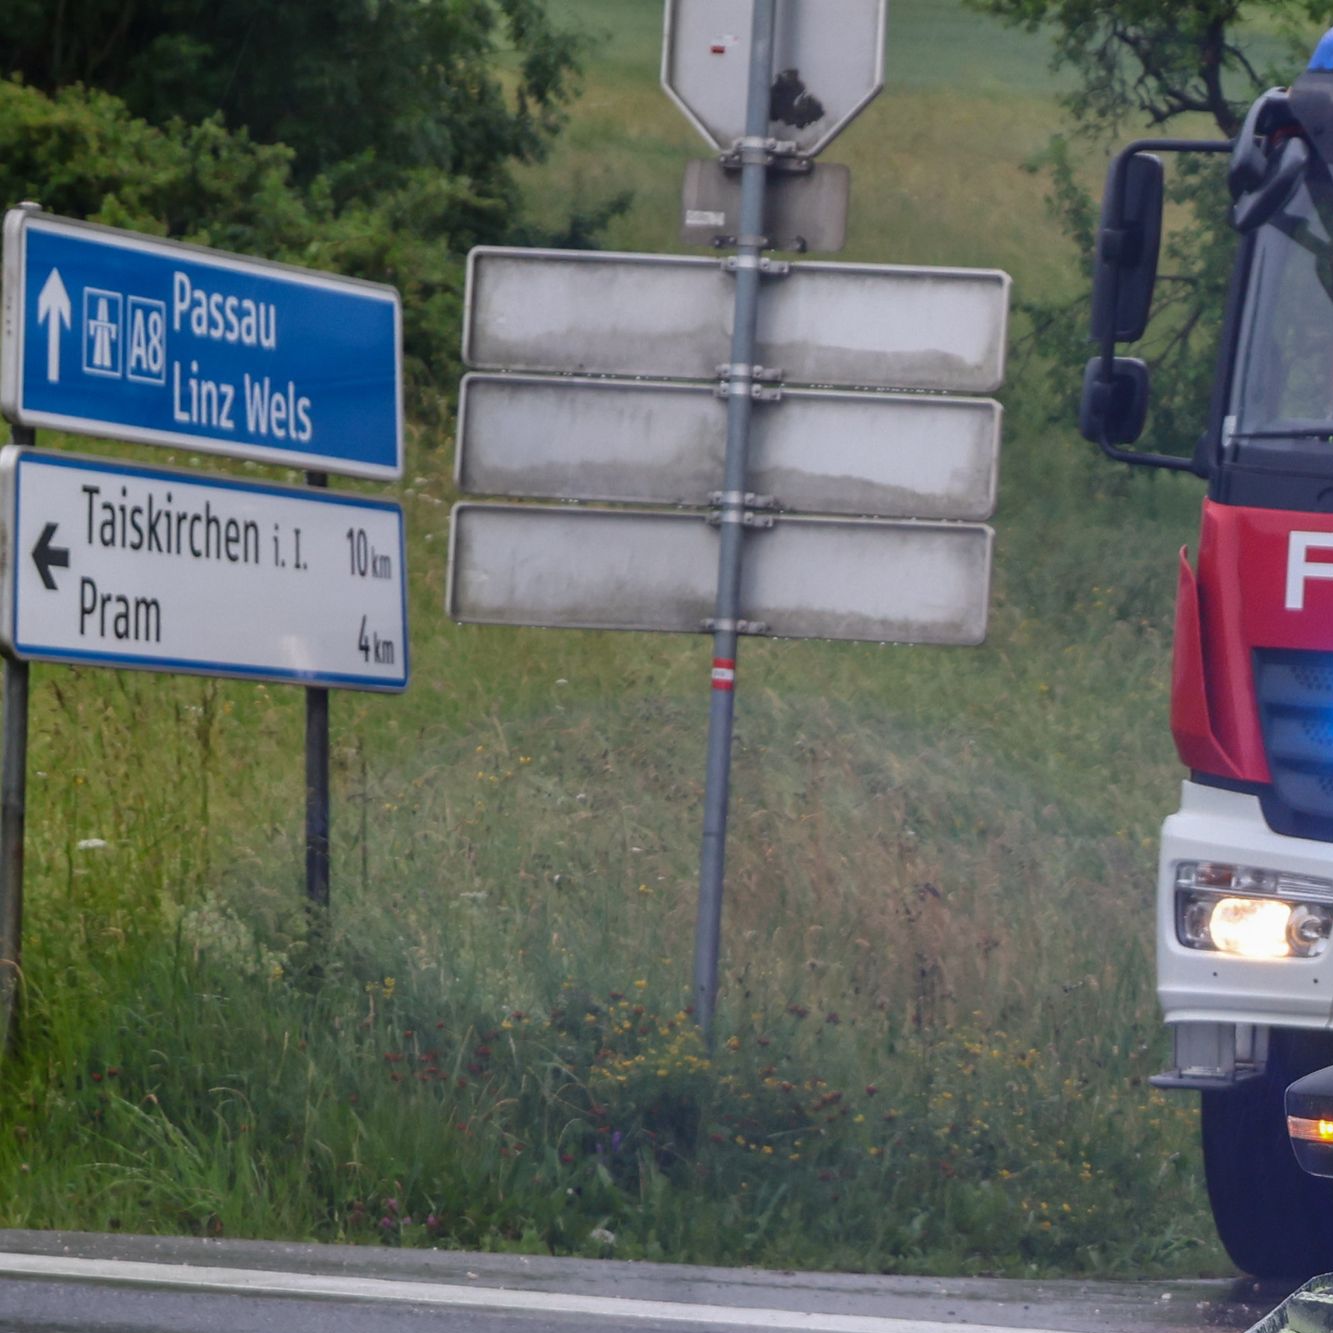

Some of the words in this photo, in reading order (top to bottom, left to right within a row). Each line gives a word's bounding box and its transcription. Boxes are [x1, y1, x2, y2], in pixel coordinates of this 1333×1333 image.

[129, 308, 164, 375] A8
[173, 271, 277, 350] Passau
[173, 361, 235, 430] Linz
[244, 373, 313, 442] Wels
[82, 484, 260, 566] Taiskirchen
[273, 523, 287, 568] i.
[346, 527, 369, 578] 10
[371, 546, 393, 580] km
[79, 576, 162, 643] Pram
[357, 616, 370, 663] 4
[374, 631, 395, 665] km
